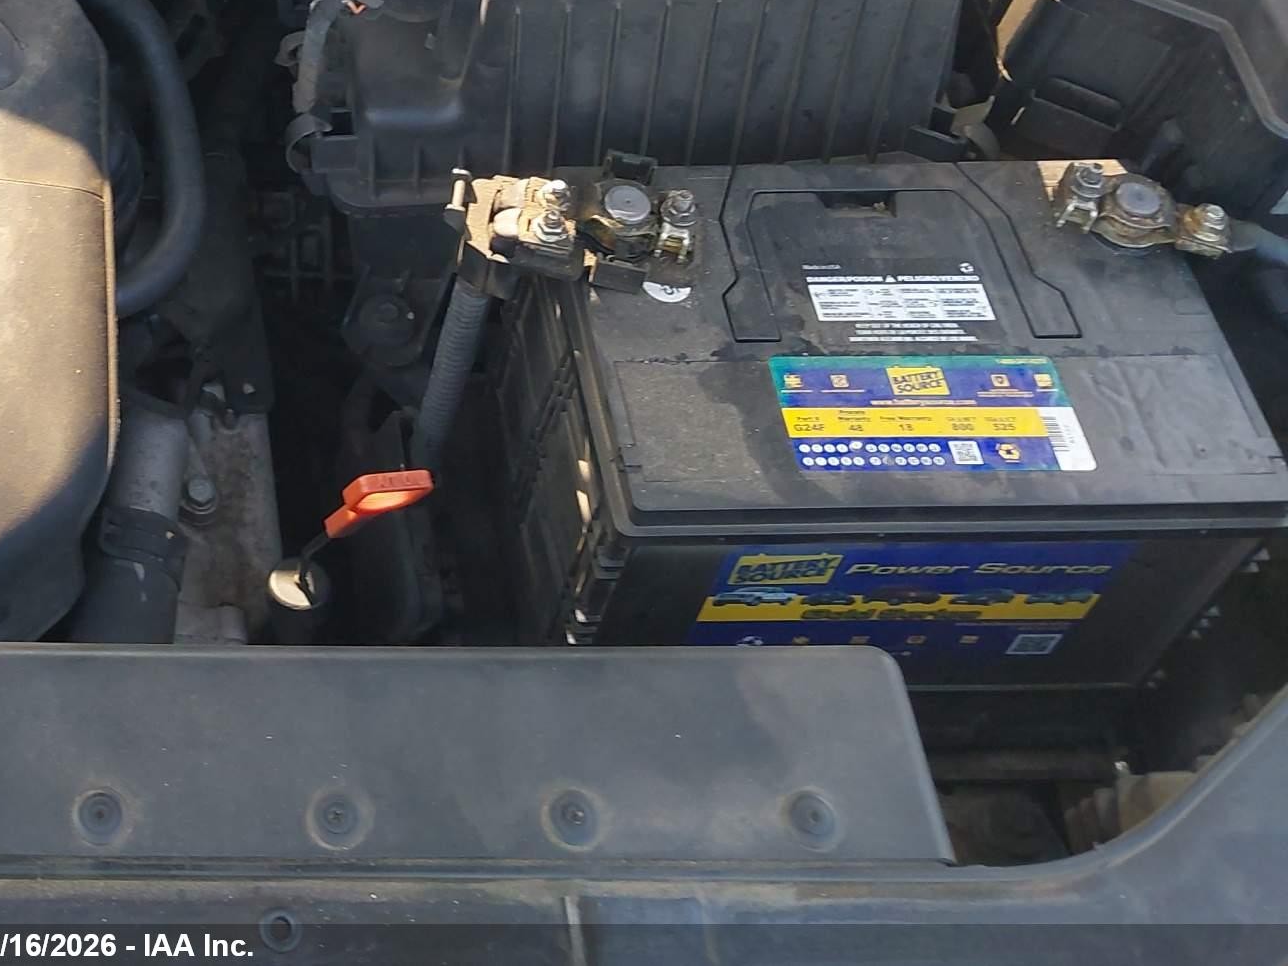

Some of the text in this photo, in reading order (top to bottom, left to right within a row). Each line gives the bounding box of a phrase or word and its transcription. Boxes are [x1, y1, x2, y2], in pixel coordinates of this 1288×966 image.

[892, 371, 938, 385] BATTERY
[896, 379, 943, 394] SOURCE
[846, 561, 1112, 576] Power Source
